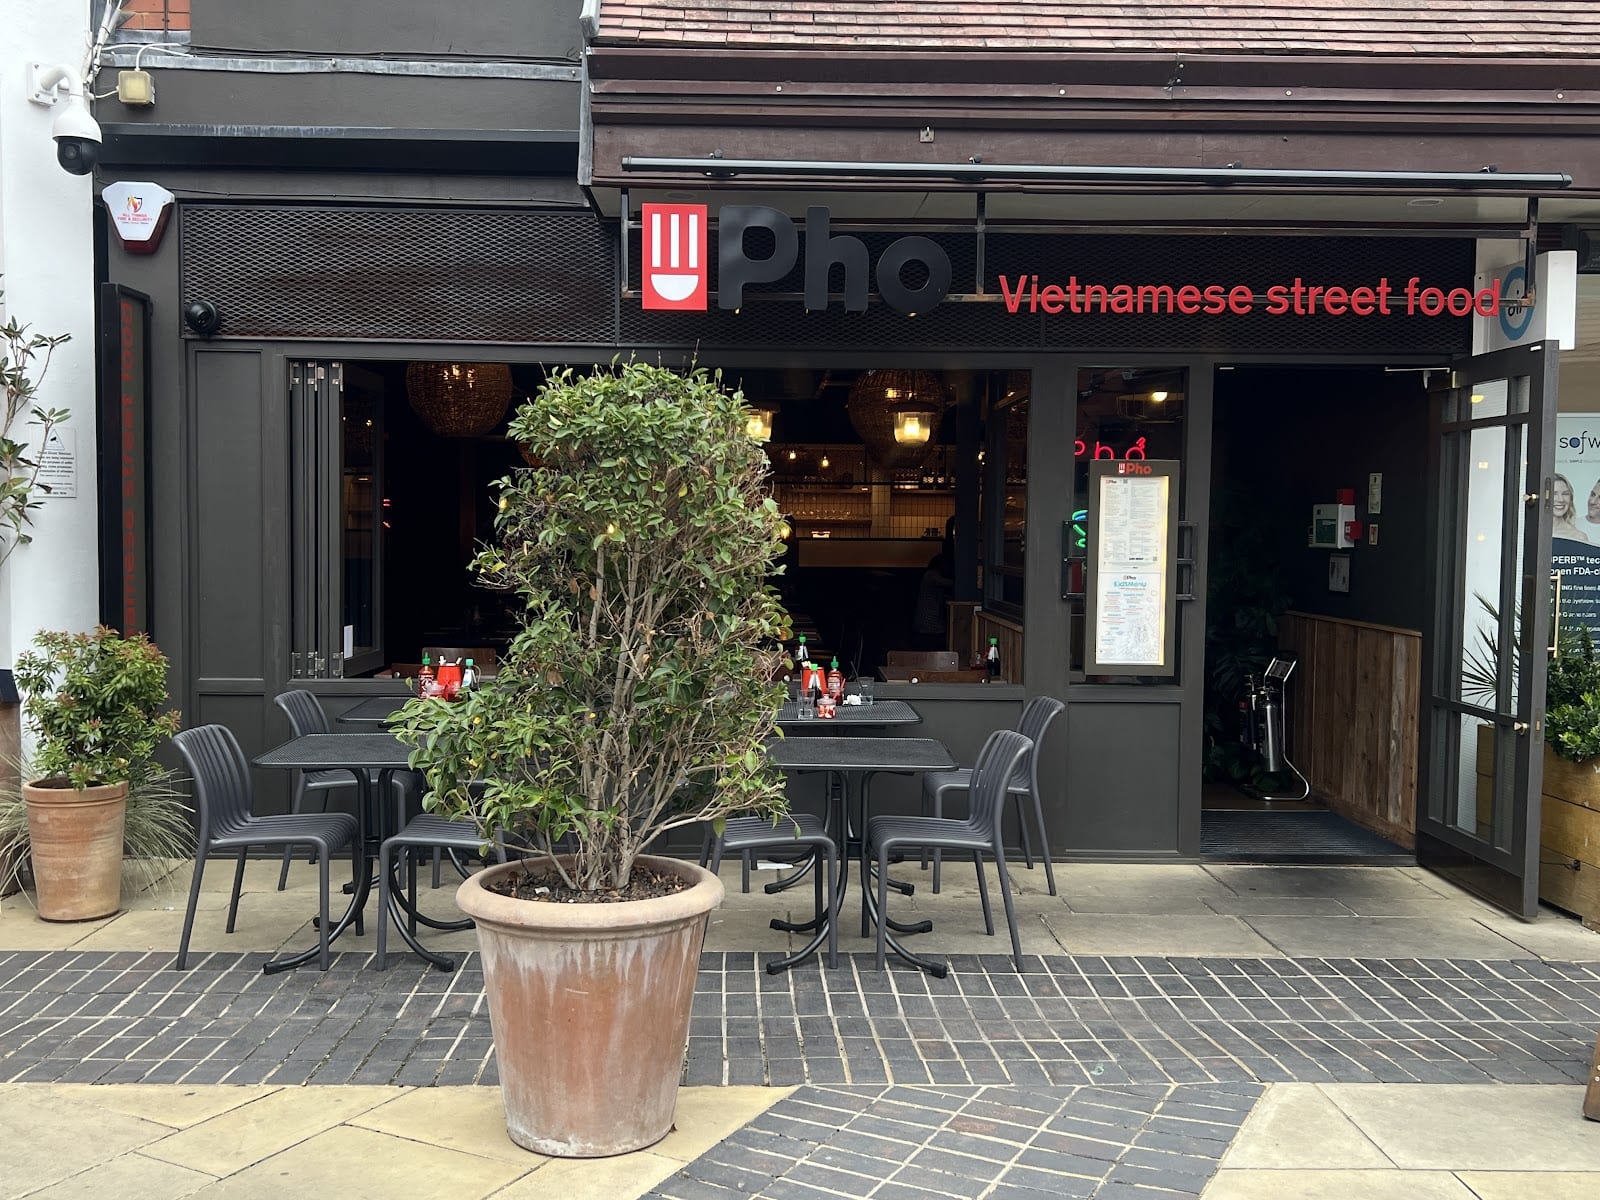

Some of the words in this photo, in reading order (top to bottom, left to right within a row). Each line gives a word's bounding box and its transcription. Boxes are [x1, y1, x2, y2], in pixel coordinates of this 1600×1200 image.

[718, 205, 952, 313] Pho
[998, 274, 1254, 314] Vietnamese
[1265, 277, 1392, 316] street
[1404, 276, 1500, 317] food
[120, 301, 134, 383] food
[121, 395, 135, 497] street
[1125, 462, 1152, 475] Pho
